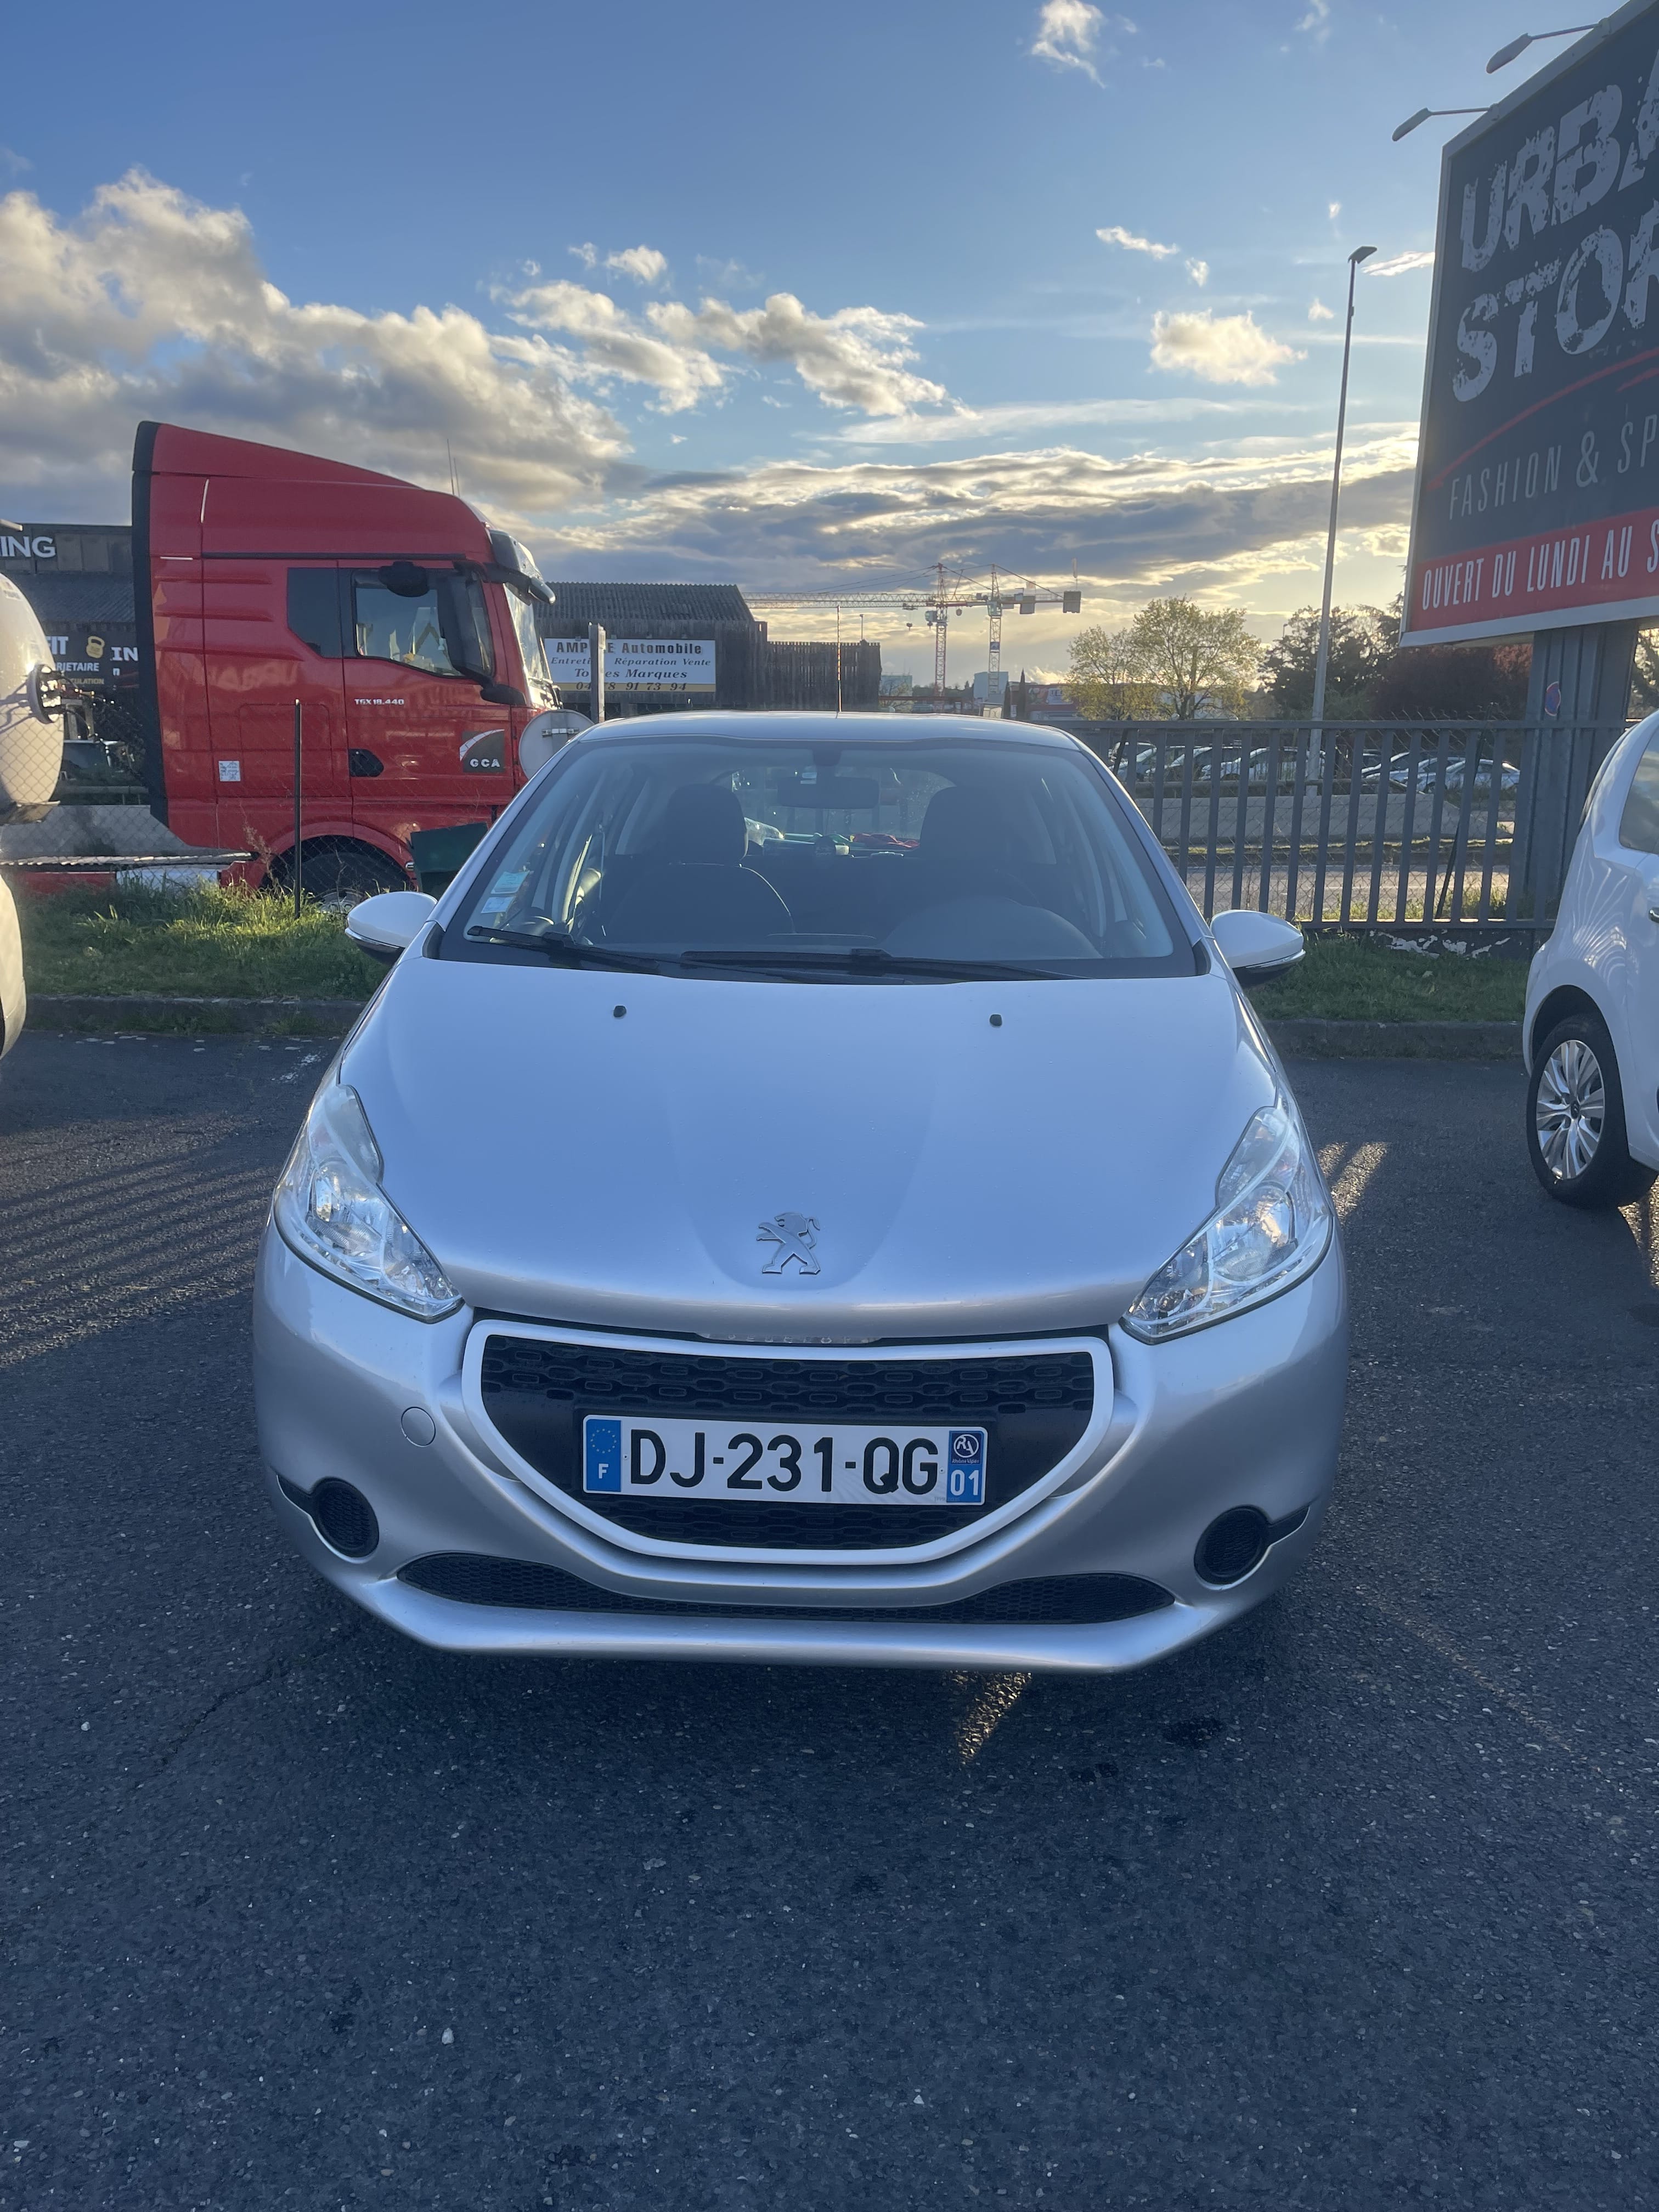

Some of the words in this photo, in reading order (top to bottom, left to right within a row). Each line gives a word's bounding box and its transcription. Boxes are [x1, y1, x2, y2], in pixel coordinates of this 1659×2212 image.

[1449, 445, 1562, 521] FASHION
[1576, 430, 1599, 488] &
[1617, 414, 1658, 473] SP
[1422, 557, 1485, 611] OUVERT
[1492, 550, 1516, 598] DU
[1527, 534, 1590, 592] LUNDI
[1600, 526, 1633, 580] AU
[556, 642, 614, 653] AMPE
[622, 642, 702, 654] Automobile
[551, 657, 591, 665] Entreti
[614, 657, 676, 667] Réparation
[574, 668, 620, 678] Toes
[625, 669, 687, 680] Marques
[625, 682, 639, 691] 91
[646, 682, 661, 691] 73
[670, 682, 686, 691] 94
[470, 758, 500, 768] GCA
[630, 1429, 939, 1494] DJ-231-QG
[599, 1464, 609, 1479] F
[950, 1469, 979, 1496] 01
